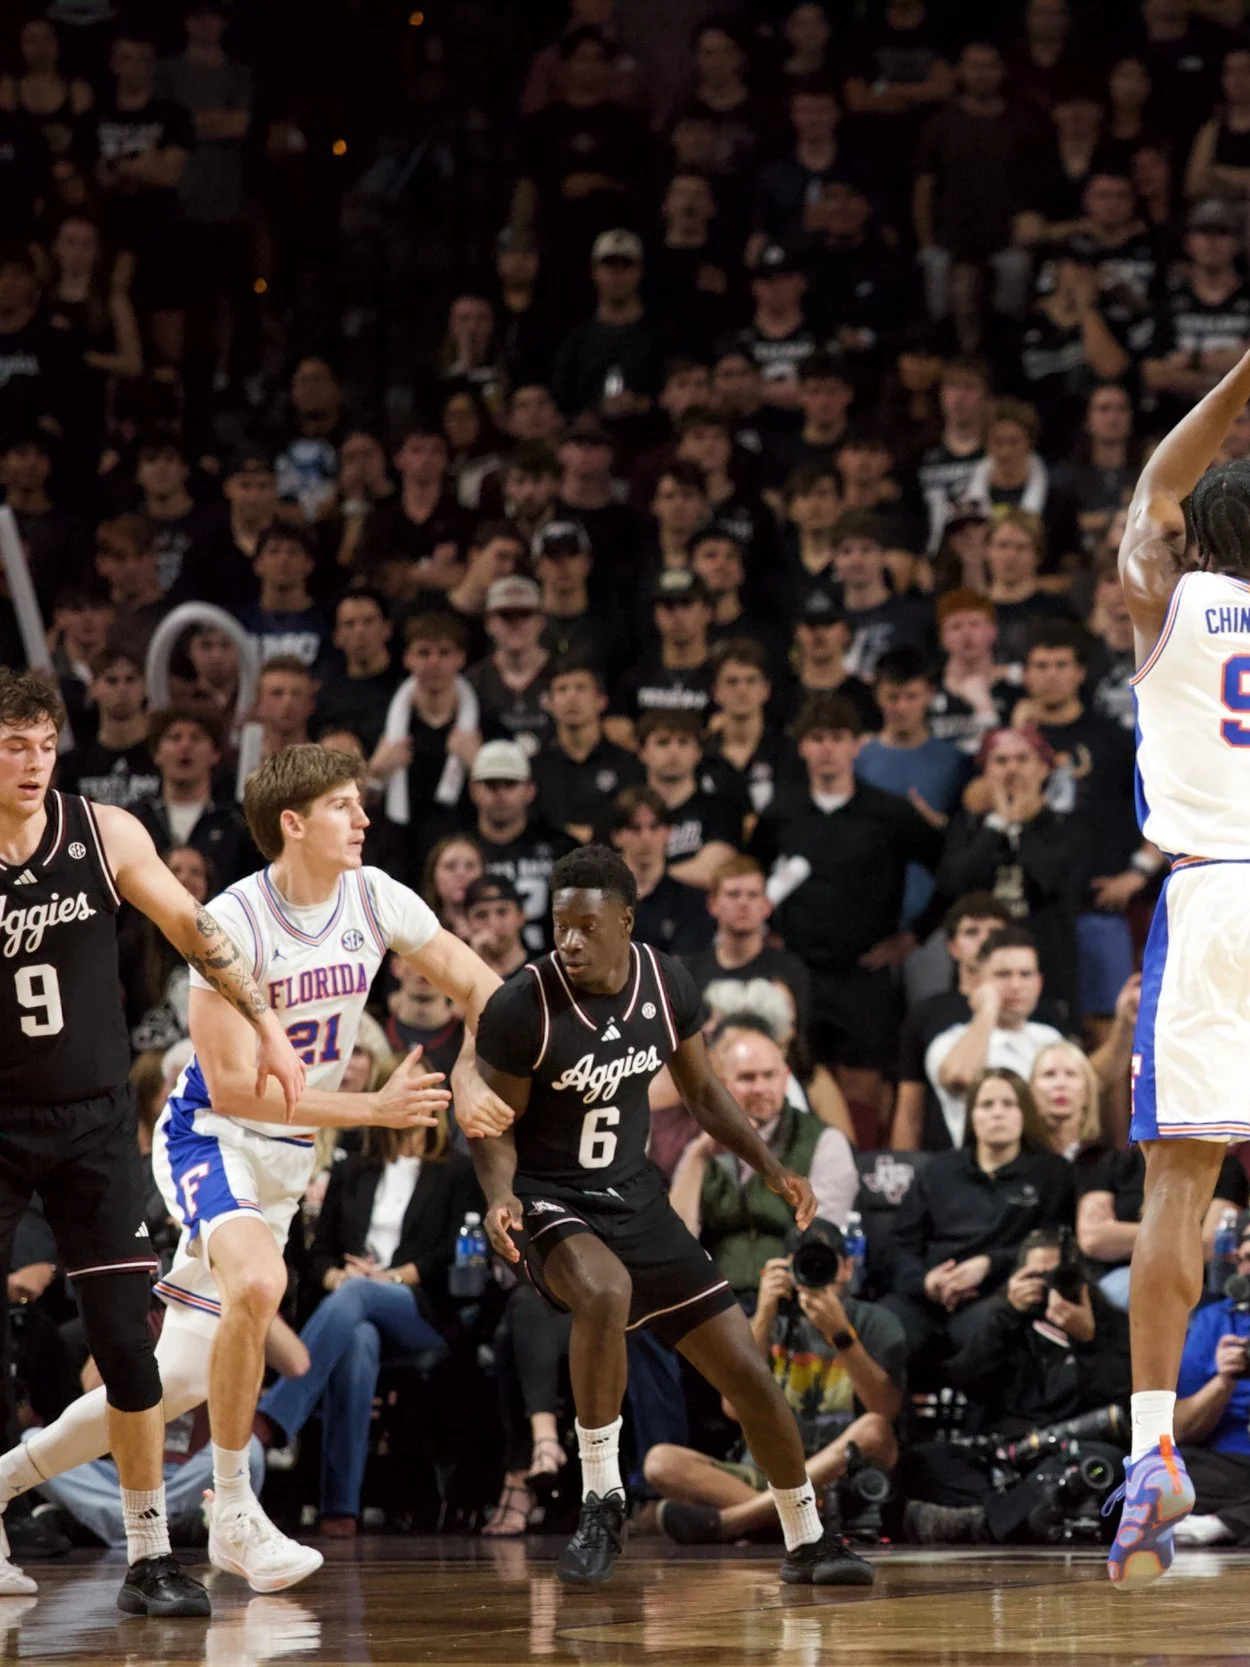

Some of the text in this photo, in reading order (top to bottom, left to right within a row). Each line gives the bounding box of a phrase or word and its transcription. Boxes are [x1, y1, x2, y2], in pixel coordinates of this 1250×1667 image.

[14, 963, 65, 1037] 9
[268, 962, 368, 1009] FLORIDA
[286, 1012, 342, 1066] 21
[551, 1045, 662, 1104] Aggies
[578, 1106, 620, 1169] 6
[179, 1162, 211, 1220] F
